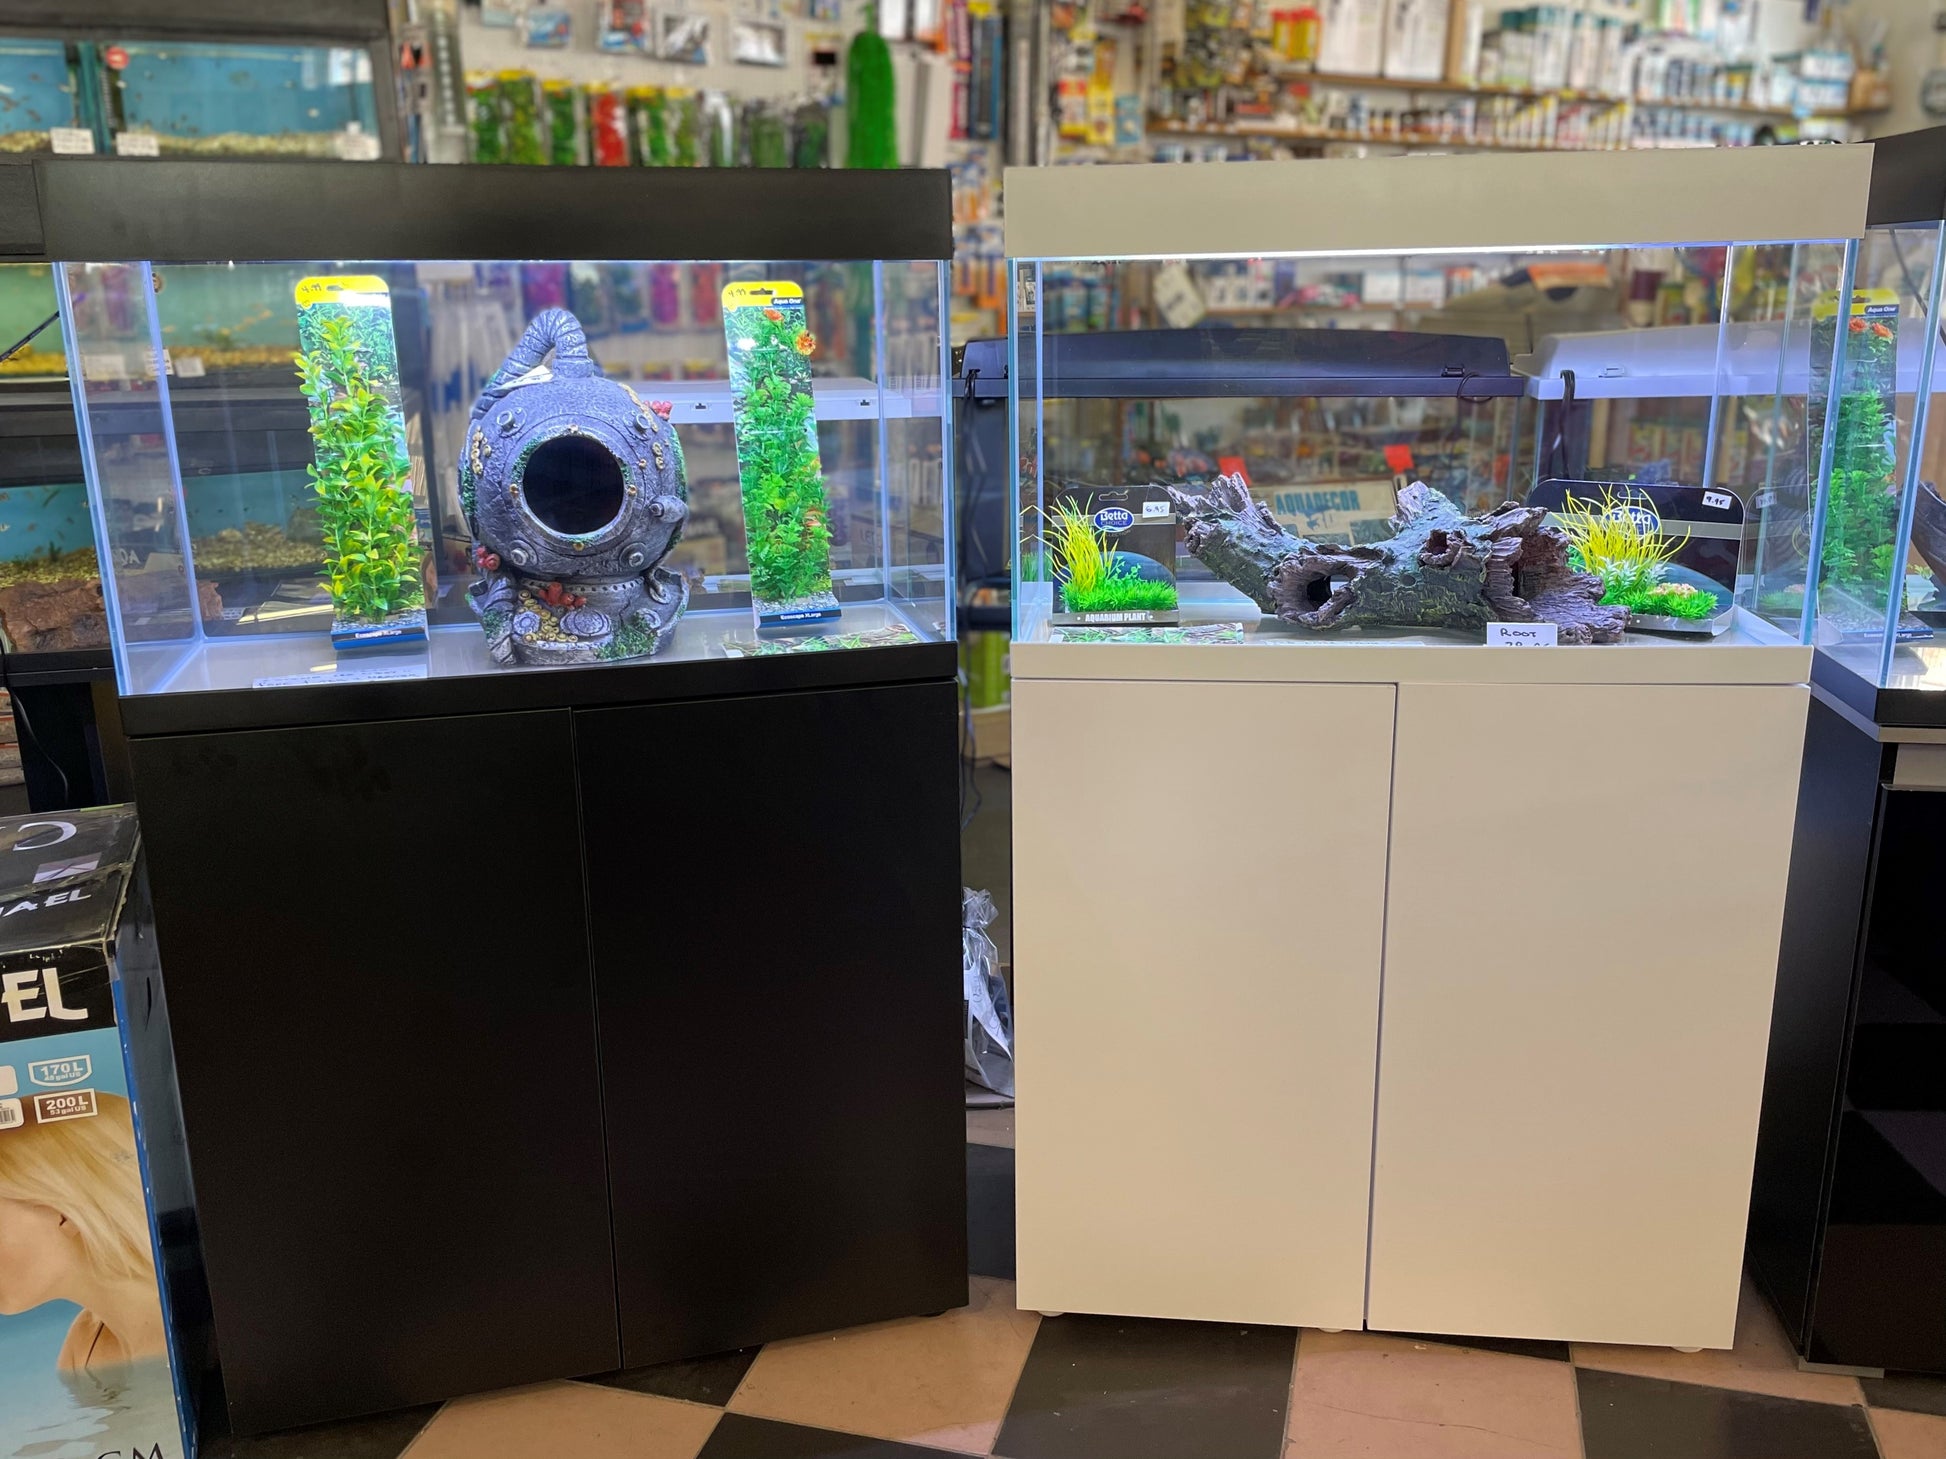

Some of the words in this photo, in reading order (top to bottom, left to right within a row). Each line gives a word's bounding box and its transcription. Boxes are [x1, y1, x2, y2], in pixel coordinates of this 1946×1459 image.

[1275, 490, 1361, 516] AQUADECOR
[1100, 510, 1129, 521] Betta
[1085, 613, 1123, 623] AQUARIUM
[1124, 612, 1146, 621] PLANT
[0, 889, 92, 917] AEL
[40, 1063, 70, 1077] 170
[73, 1062, 84, 1072] L
[55, 1072, 69, 1082] gal
[46, 1096, 76, 1111] 200
[78, 1096, 89, 1106] L
[61, 1106, 74, 1115] gal
